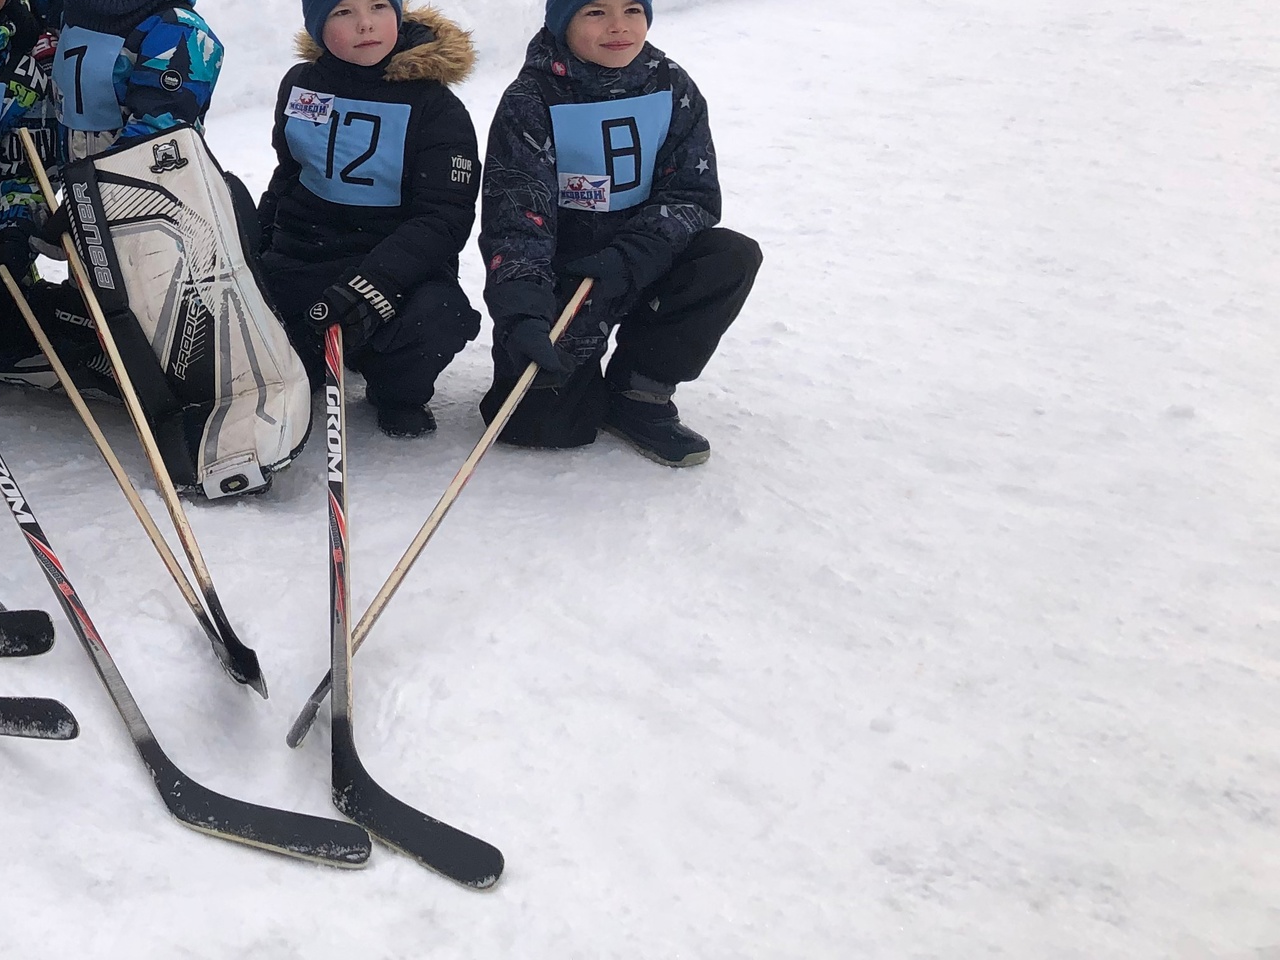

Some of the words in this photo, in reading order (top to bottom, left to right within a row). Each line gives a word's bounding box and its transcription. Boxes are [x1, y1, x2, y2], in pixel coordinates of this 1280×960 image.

[314, 109, 381, 187] 12
[451, 169, 472, 185] CITY
[602, 116, 641, 194] 8
[72, 181, 116, 290] BAUER
[325, 384, 344, 483] GROM
